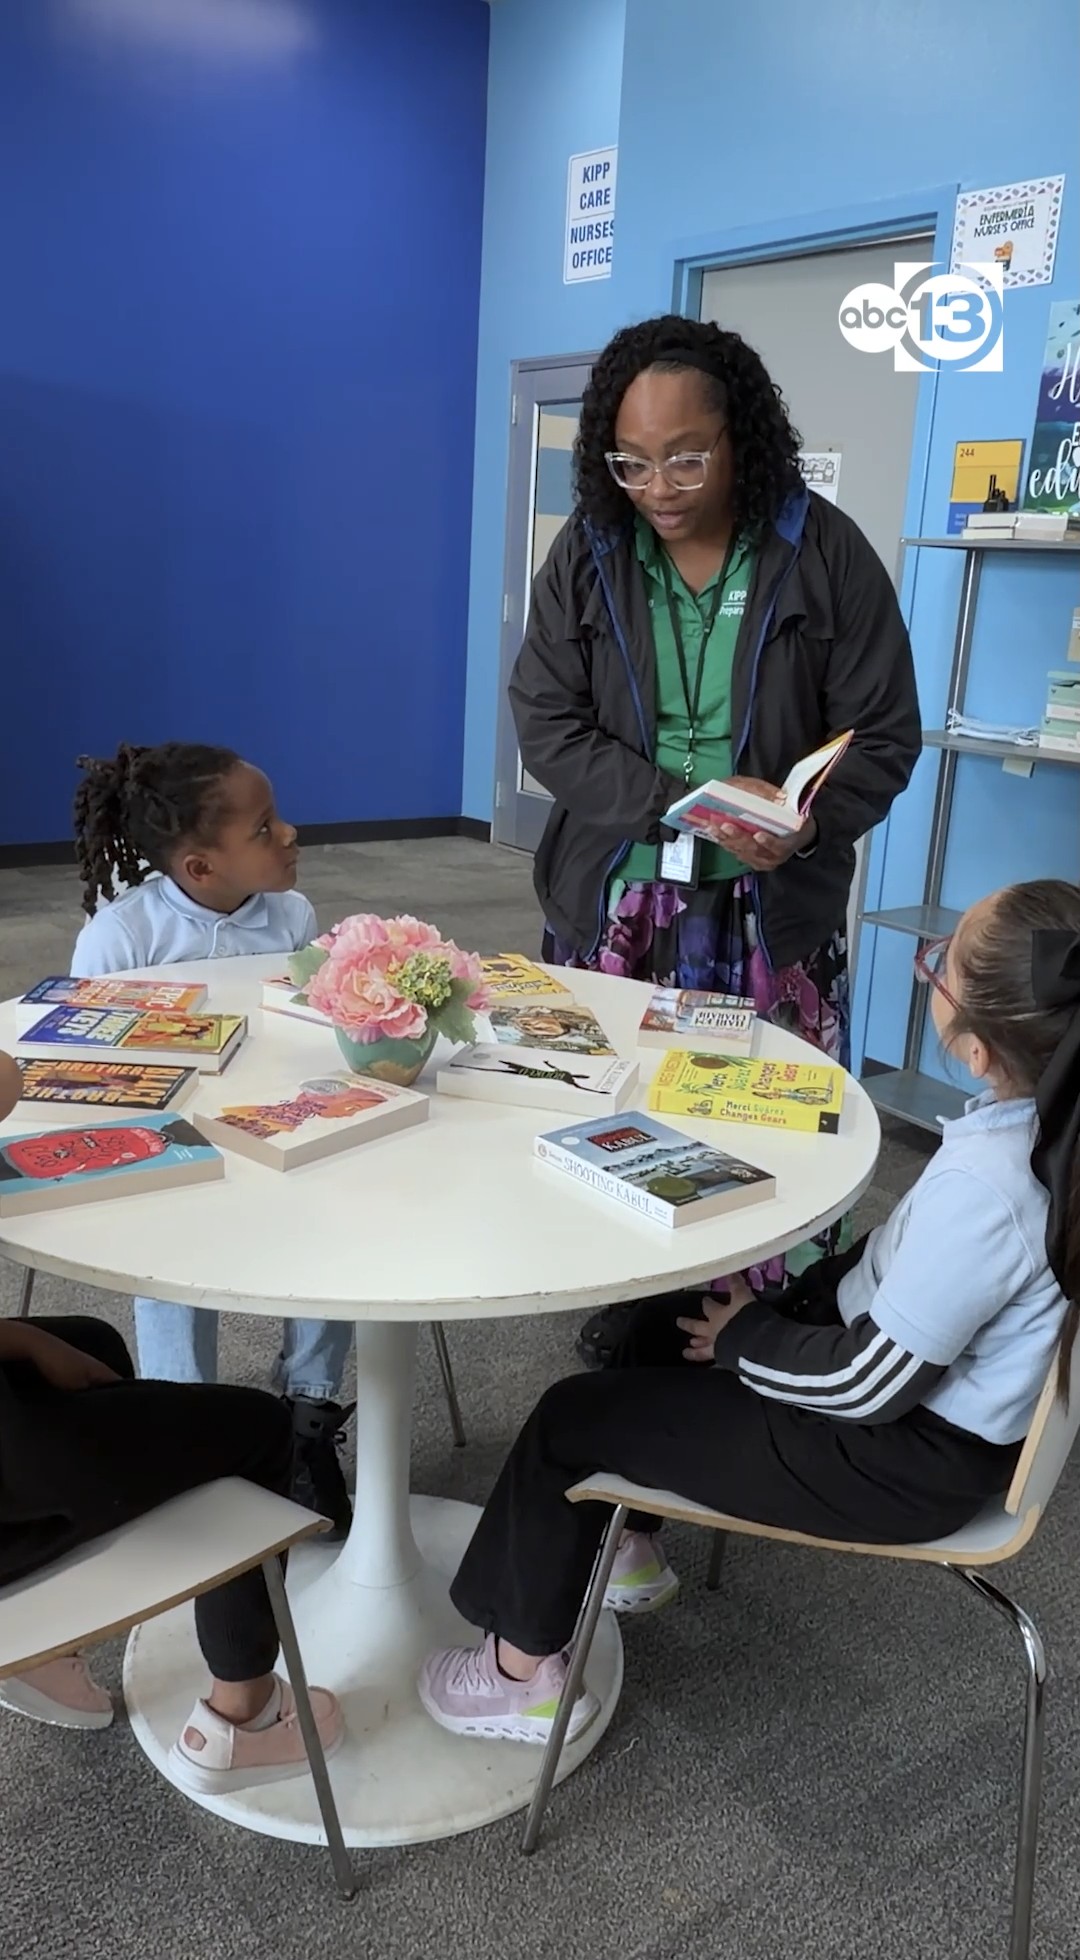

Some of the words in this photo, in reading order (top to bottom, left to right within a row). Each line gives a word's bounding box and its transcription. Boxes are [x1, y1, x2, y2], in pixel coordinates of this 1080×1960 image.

[583, 162, 611, 184] KIPP
[579, 187, 611, 210] CARE
[570, 219, 615, 244] NURSES
[974, 222, 1008, 238] NURSE'S
[1010, 217, 1035, 231] OFFICE
[572, 246, 613, 269] OFFICE
[960, 448, 975, 458] 244
[728, 590, 747, 601] KIPP
[57, 1009, 106, 1036] KEYS
[86, 1011, 139, 1041] THREE
[55, 1061, 146, 1076] BROTHER
[22, 1086, 122, 1104] BROTHE
[115, 1067, 186, 1106] BLACK
[720, 1108, 758, 1122] Changes
[760, 1113, 787, 1125] Gears
[726, 1100, 750, 1111] Merci
[753, 1102, 785, 1115] Suárez
[602, 1134, 652, 1151] KABUL
[564, 1156, 614, 1193] SHOOTING
[616, 1182, 653, 1214] KABUL
